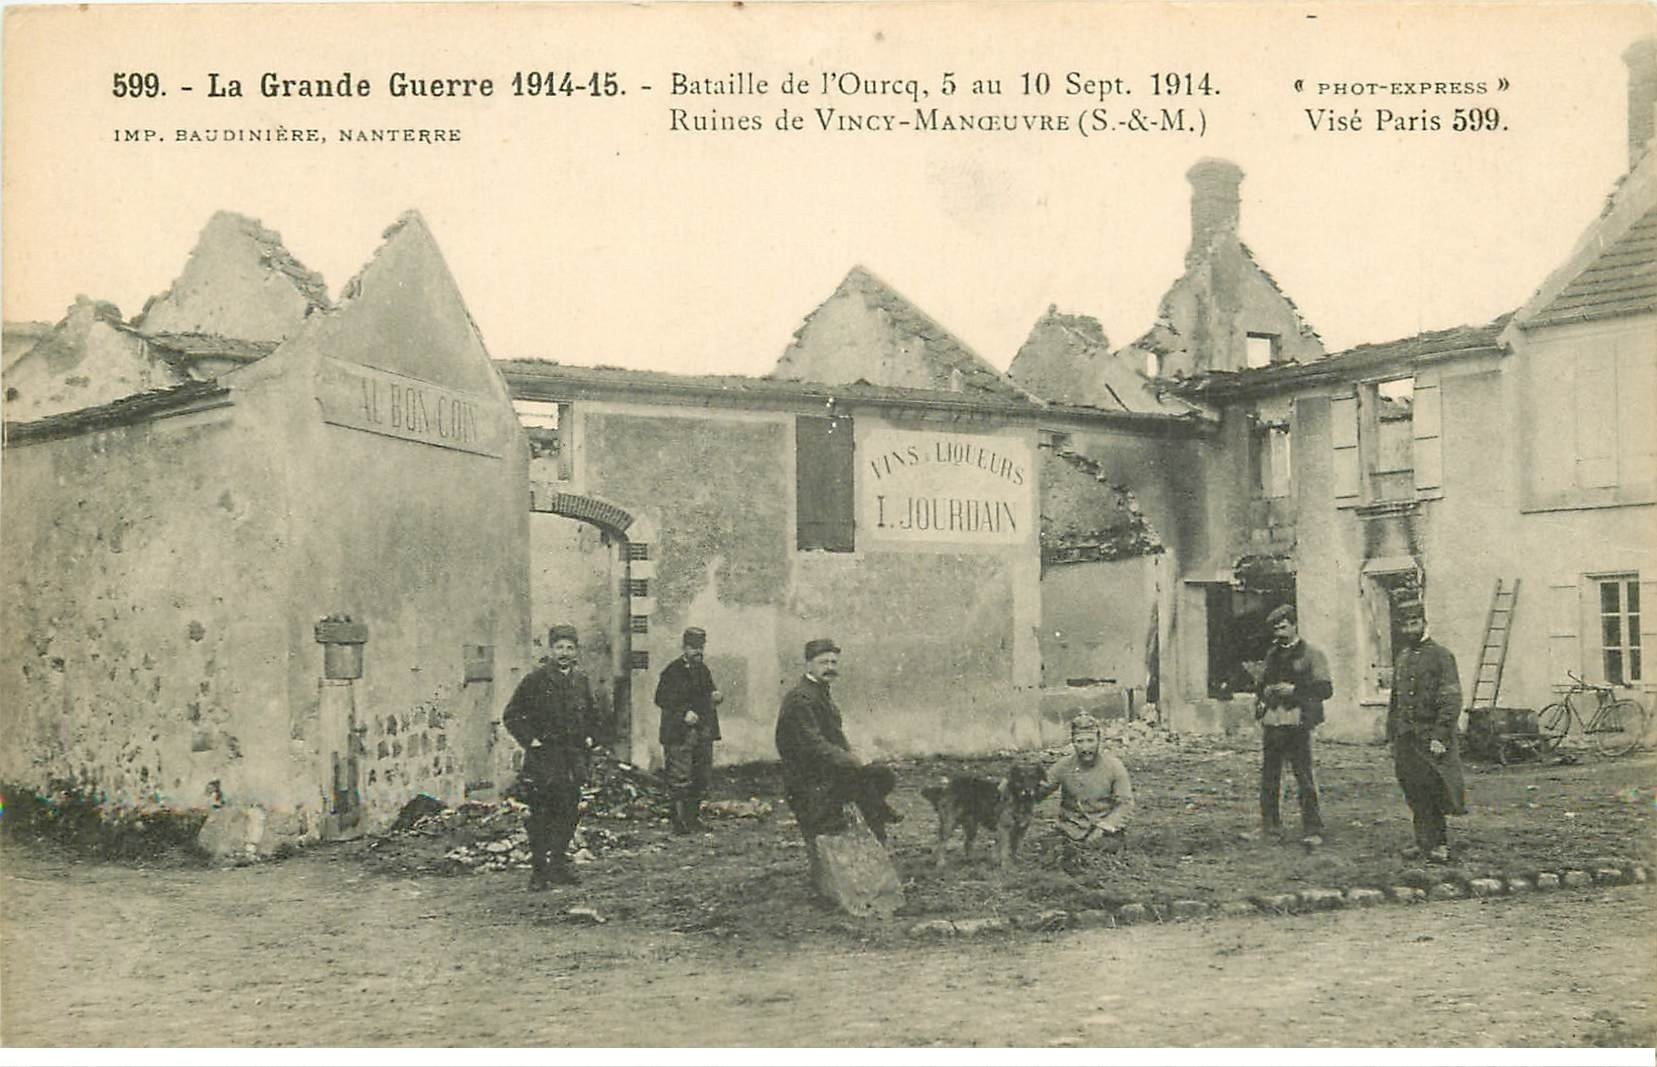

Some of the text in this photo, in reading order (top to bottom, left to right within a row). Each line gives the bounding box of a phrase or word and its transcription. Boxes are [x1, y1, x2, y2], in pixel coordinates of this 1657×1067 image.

[390, 383, 430, 434] BON
[870, 441, 1024, 487] VINS LIQUEURS
[899, 496, 1017, 534] JOURDAIN
